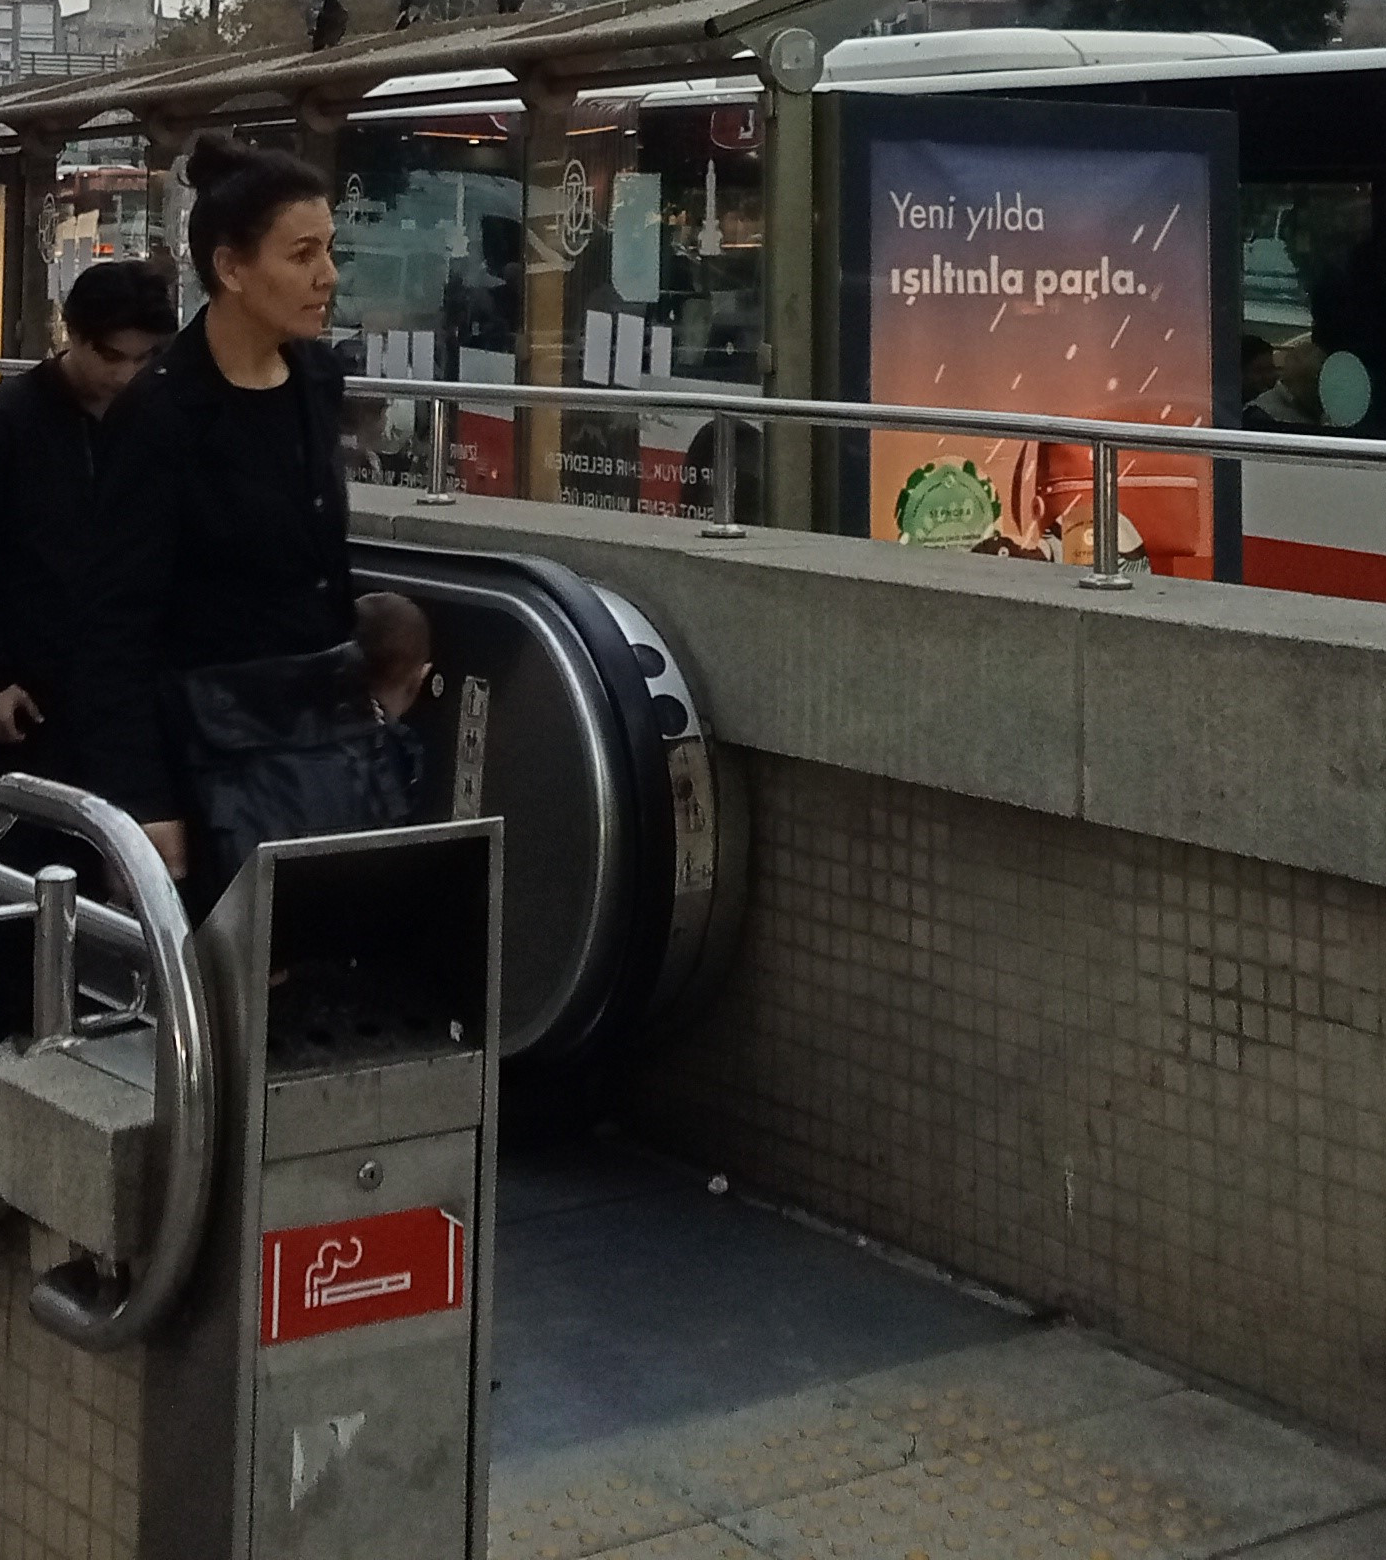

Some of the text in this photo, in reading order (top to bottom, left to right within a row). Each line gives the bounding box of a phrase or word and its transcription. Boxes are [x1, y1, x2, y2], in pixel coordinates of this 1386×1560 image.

[890, 191, 1044, 241] Yeni yılda
[891, 254, 1147, 307] ışıltınla parla.
